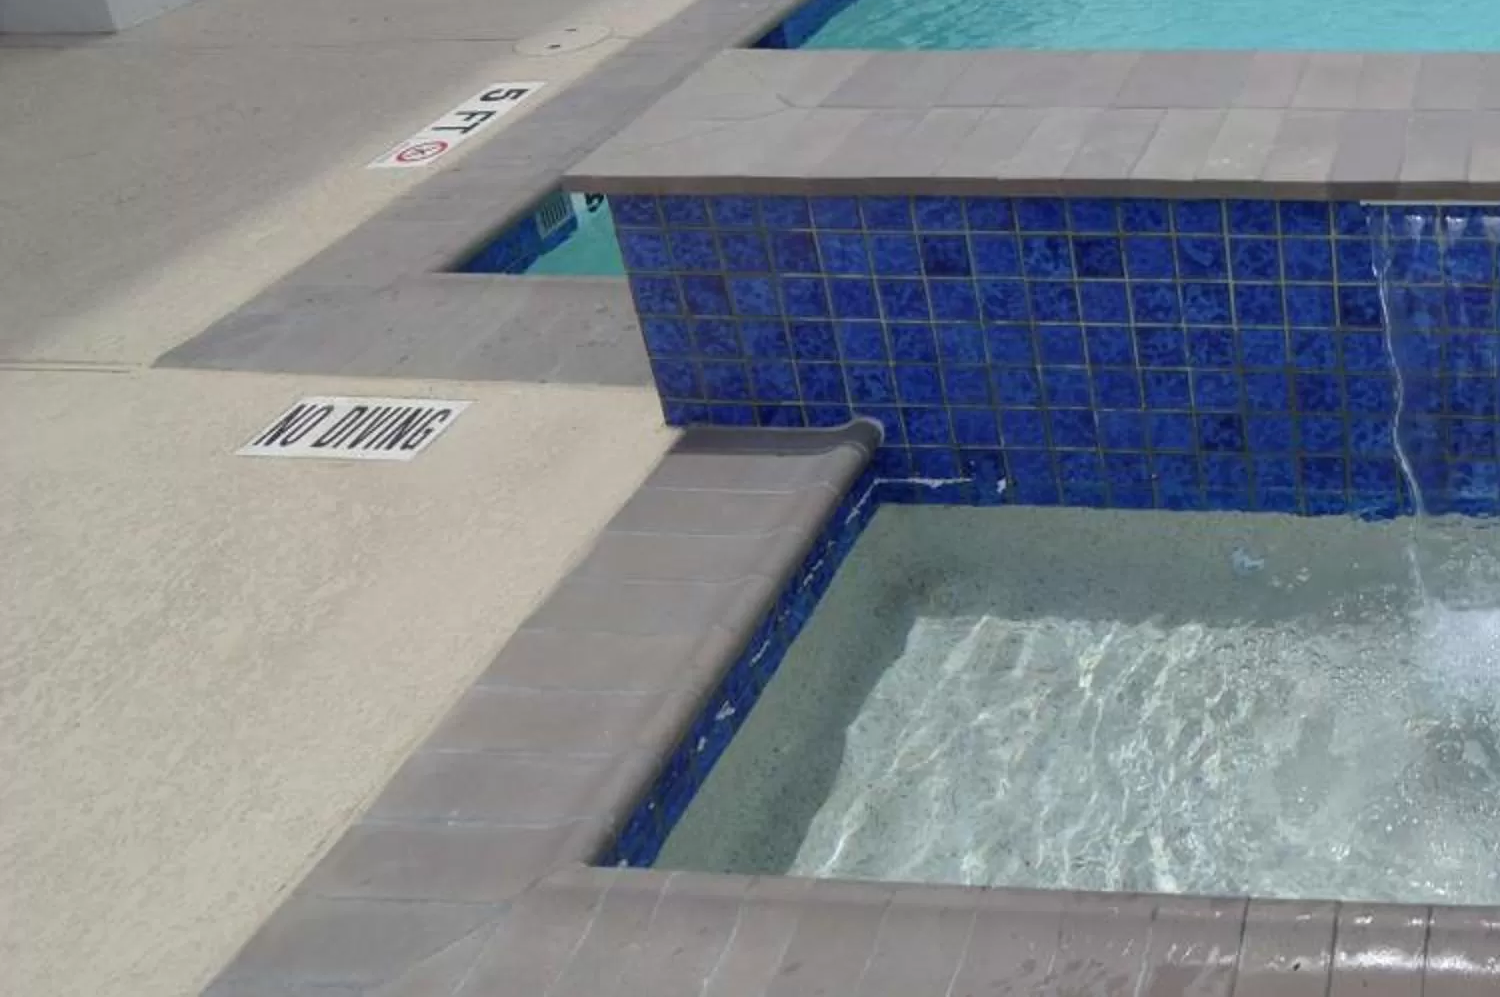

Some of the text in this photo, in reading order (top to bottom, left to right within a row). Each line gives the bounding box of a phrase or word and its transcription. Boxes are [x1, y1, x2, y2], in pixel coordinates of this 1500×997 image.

[432, 87, 529, 134] 5 FT
[251, 403, 453, 451] NO DIVING
